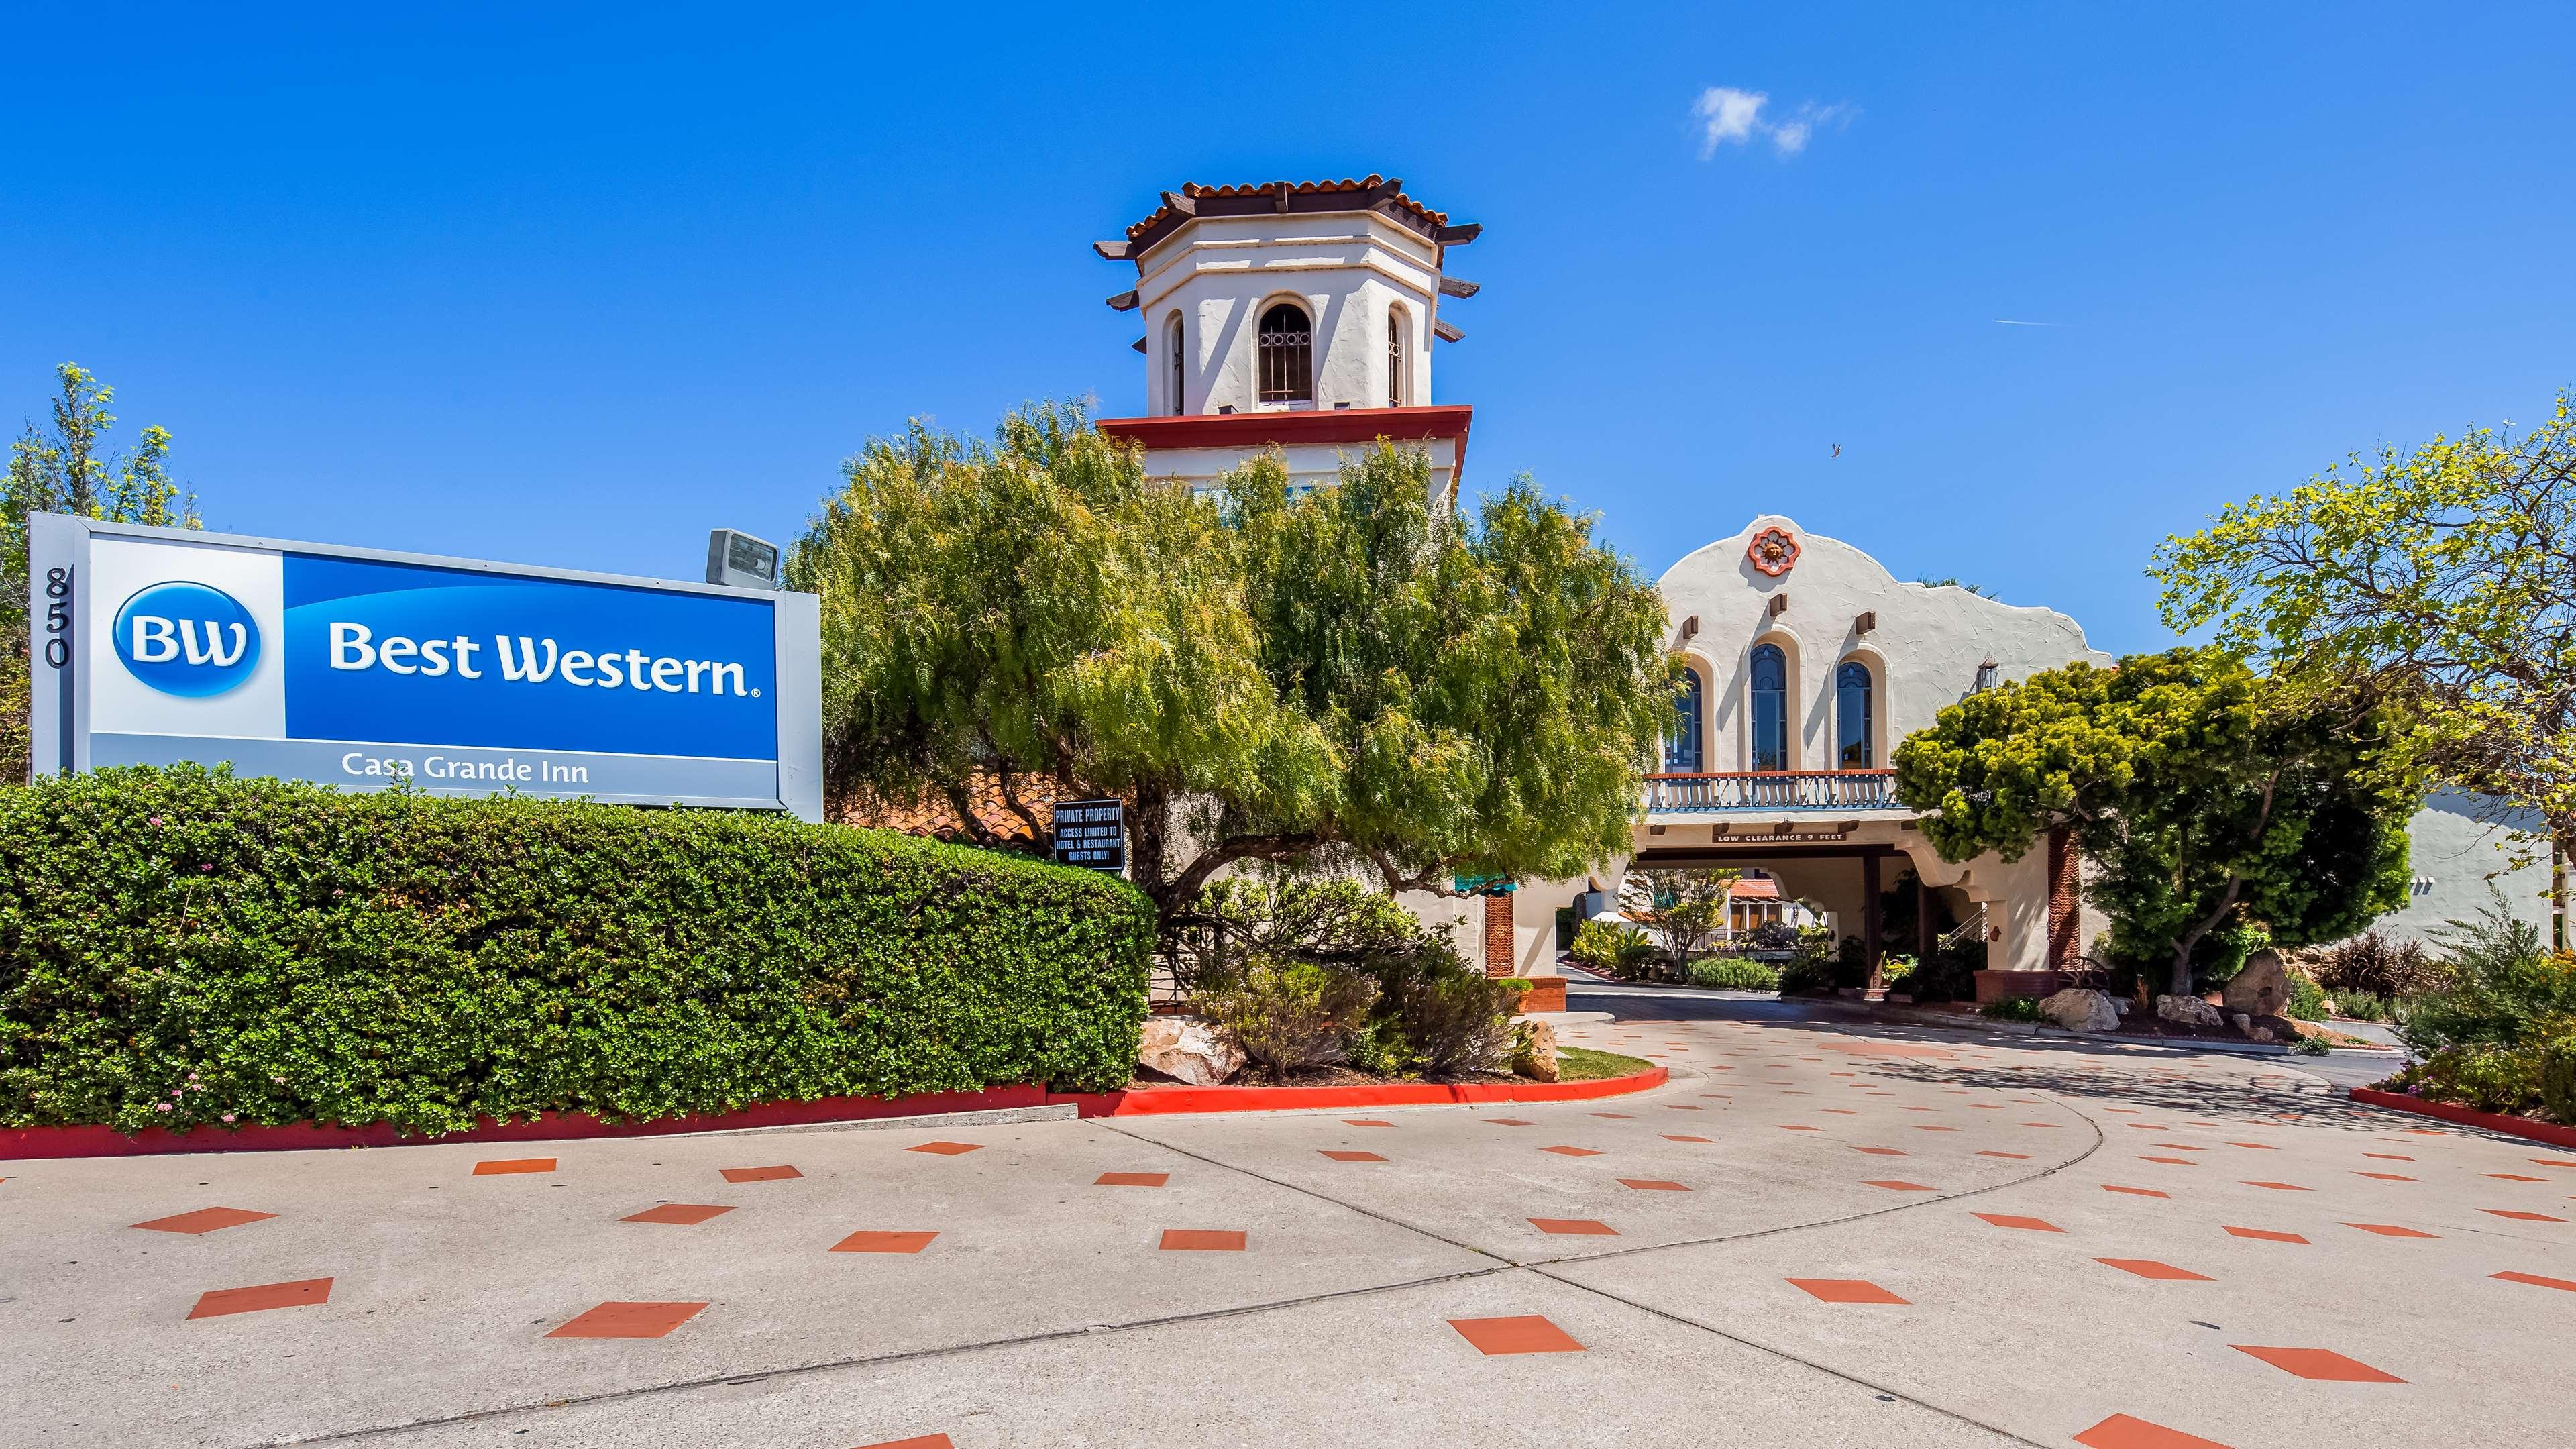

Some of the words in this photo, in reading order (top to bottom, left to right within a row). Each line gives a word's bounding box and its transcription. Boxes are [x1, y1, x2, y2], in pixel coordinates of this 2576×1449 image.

[46, 567, 68, 669] 850
[132, 615, 246, 667] BW
[330, 622, 481, 678] Best
[341, 752, 414, 777] Casa
[423, 755, 532, 781] Grande
[542, 761, 588, 783] Inn
[1056, 810, 1083, 823] PRIVATE
[1085, 807, 1120, 822] PROPERTY
[1060, 828, 1082, 838] ACCESS
[1084, 827, 1108, 837] LIMITED
[1110, 826, 1117, 836] TO
[1057, 841, 1074, 849] HOTEL
[1076, 840, 1081, 849] &
[1083, 839, 1120, 849] RESTAURANT
[1069, 851, 1091, 861] GUESTS
[1093, 851, 1110, 860] ONLY!
